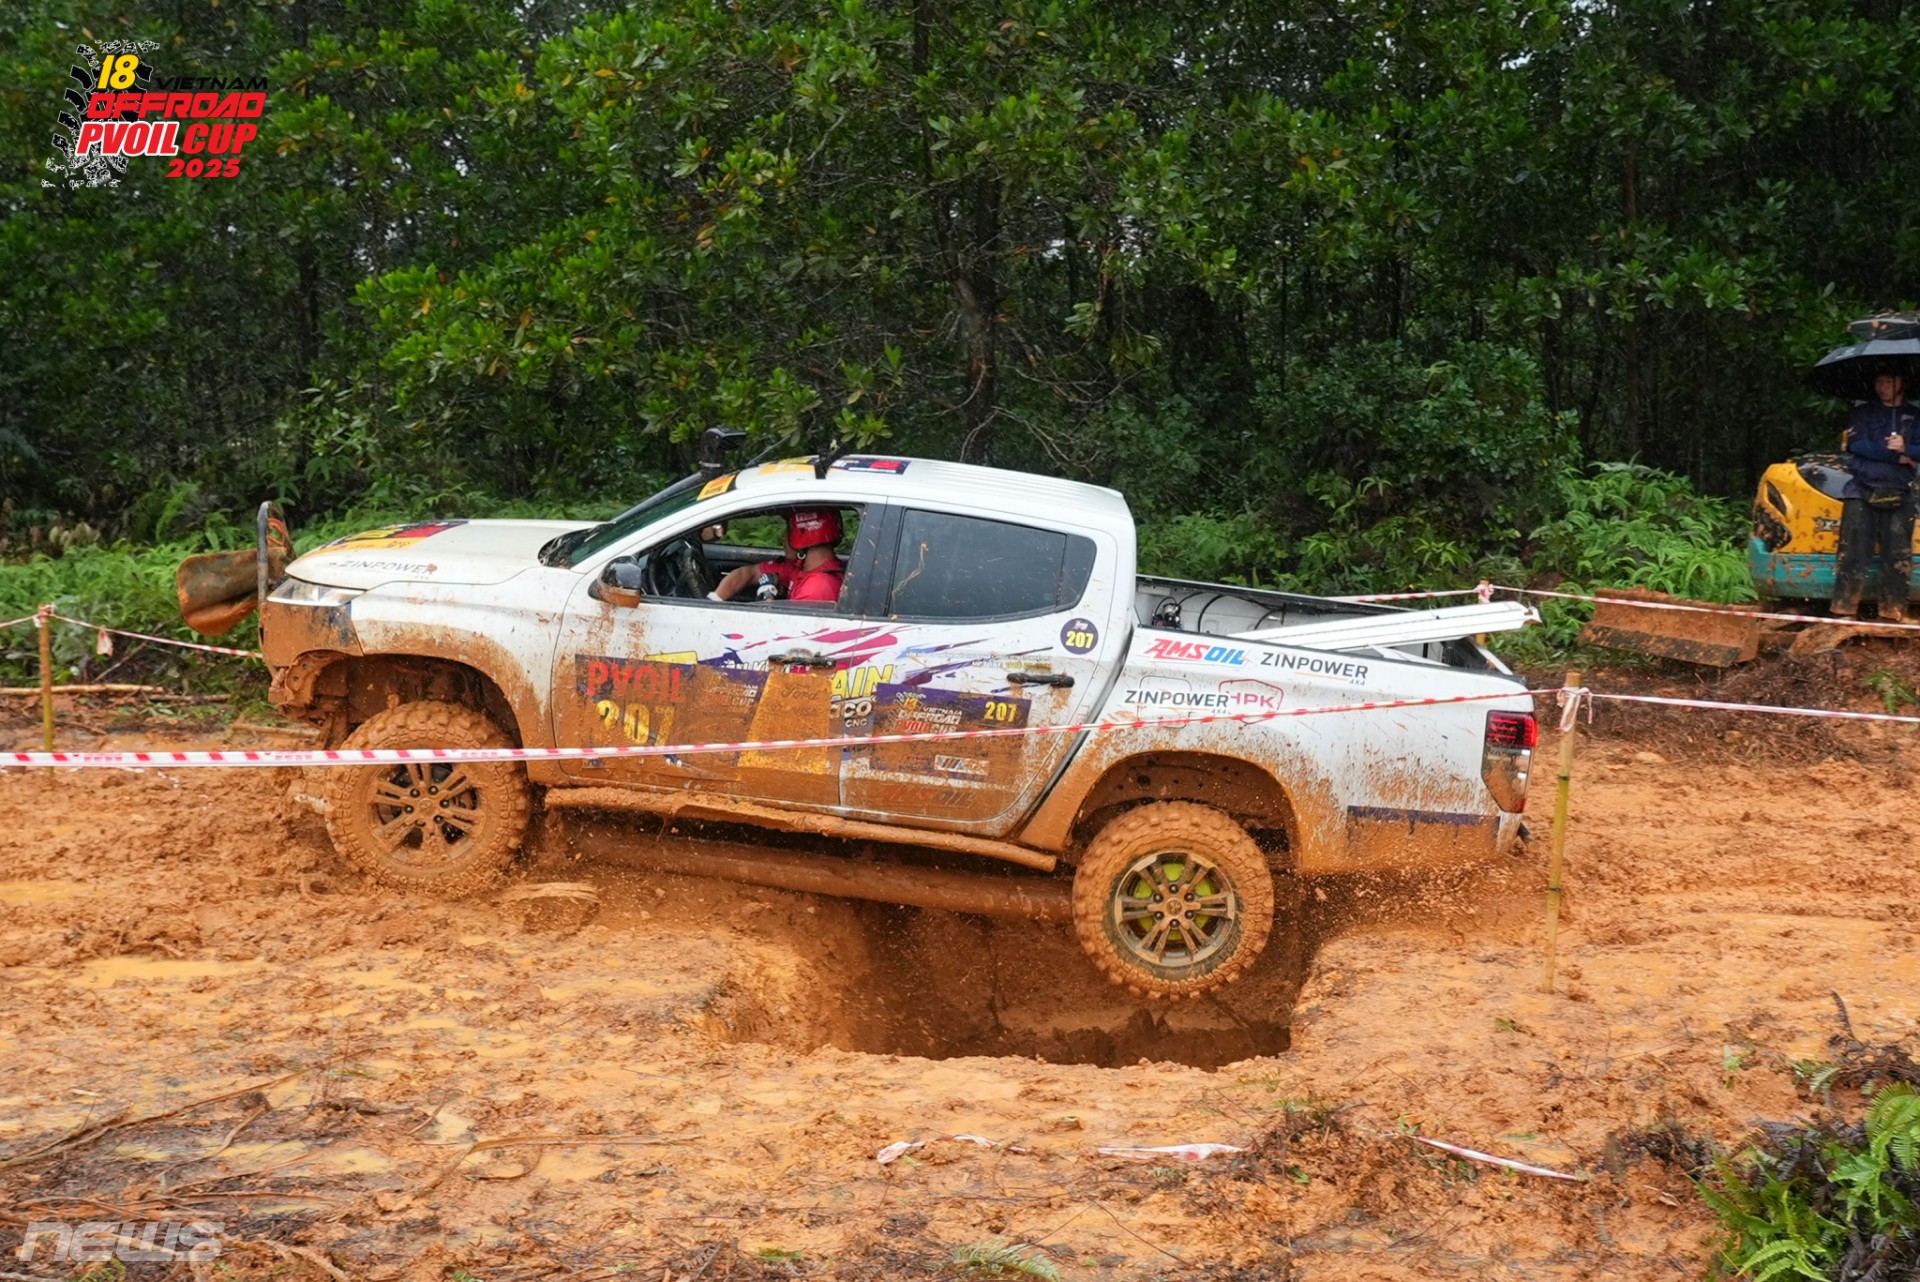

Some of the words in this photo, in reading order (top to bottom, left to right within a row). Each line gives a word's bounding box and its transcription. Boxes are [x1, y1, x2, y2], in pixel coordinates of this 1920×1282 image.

[339, 560, 437, 575] ZINPOWER
[1065, 631, 1094, 649] 207
[1143, 638, 1246, 665] AMSOIL
[1260, 652, 1369, 680] ZINPOWER
[586, 660, 687, 704] PVOIL
[1124, 689, 1230, 709] ZINPOWER
[984, 701, 1018, 723] 207
